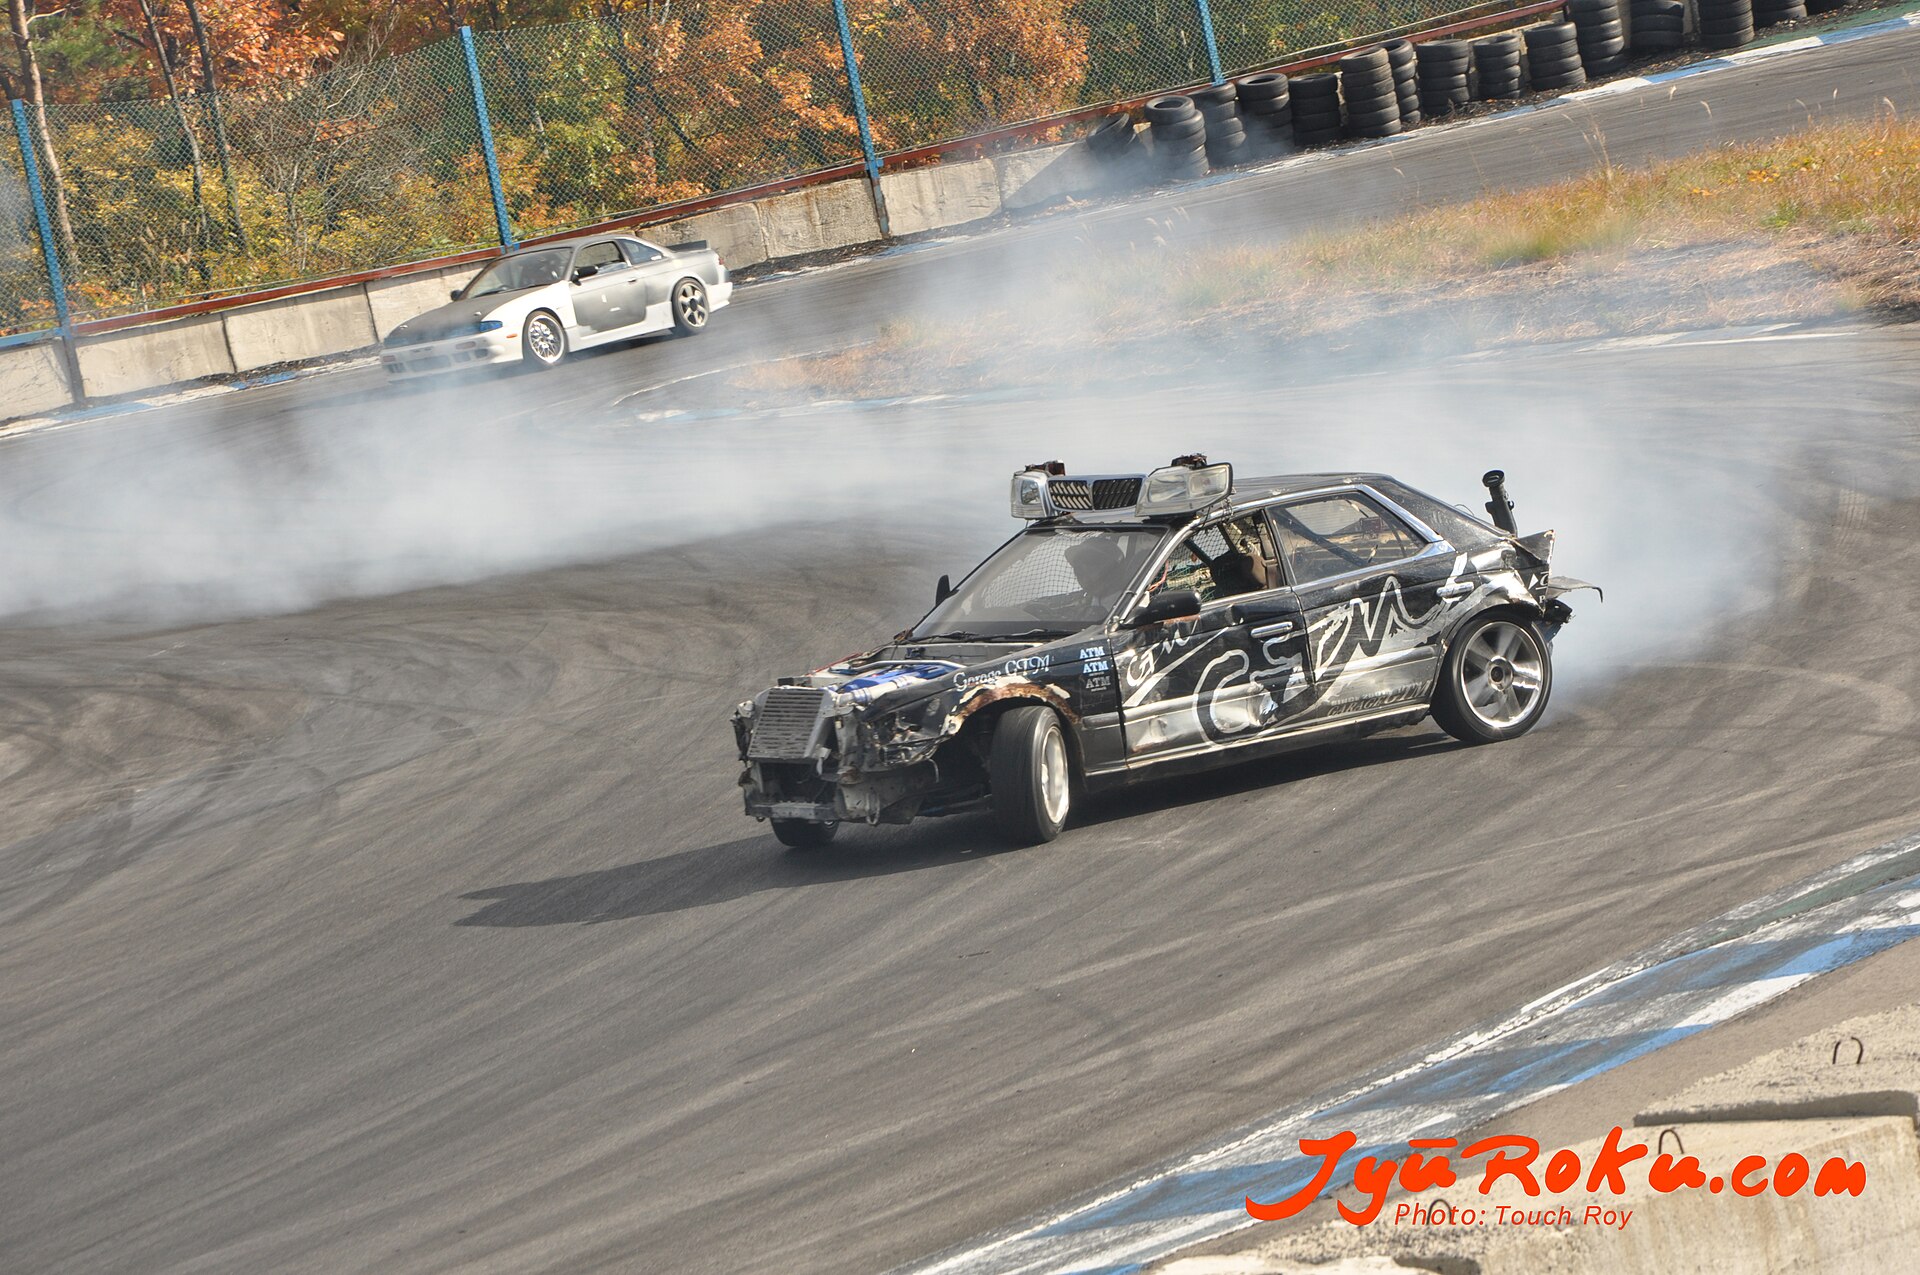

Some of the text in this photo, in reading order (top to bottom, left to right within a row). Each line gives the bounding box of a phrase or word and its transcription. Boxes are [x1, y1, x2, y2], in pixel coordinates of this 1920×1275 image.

[1079, 646, 1106, 660] ATM
[1082, 660, 1109, 674] ATM
[1085, 675, 1111, 689] ATM
[1327, 696, 1384, 716] GARAGE
